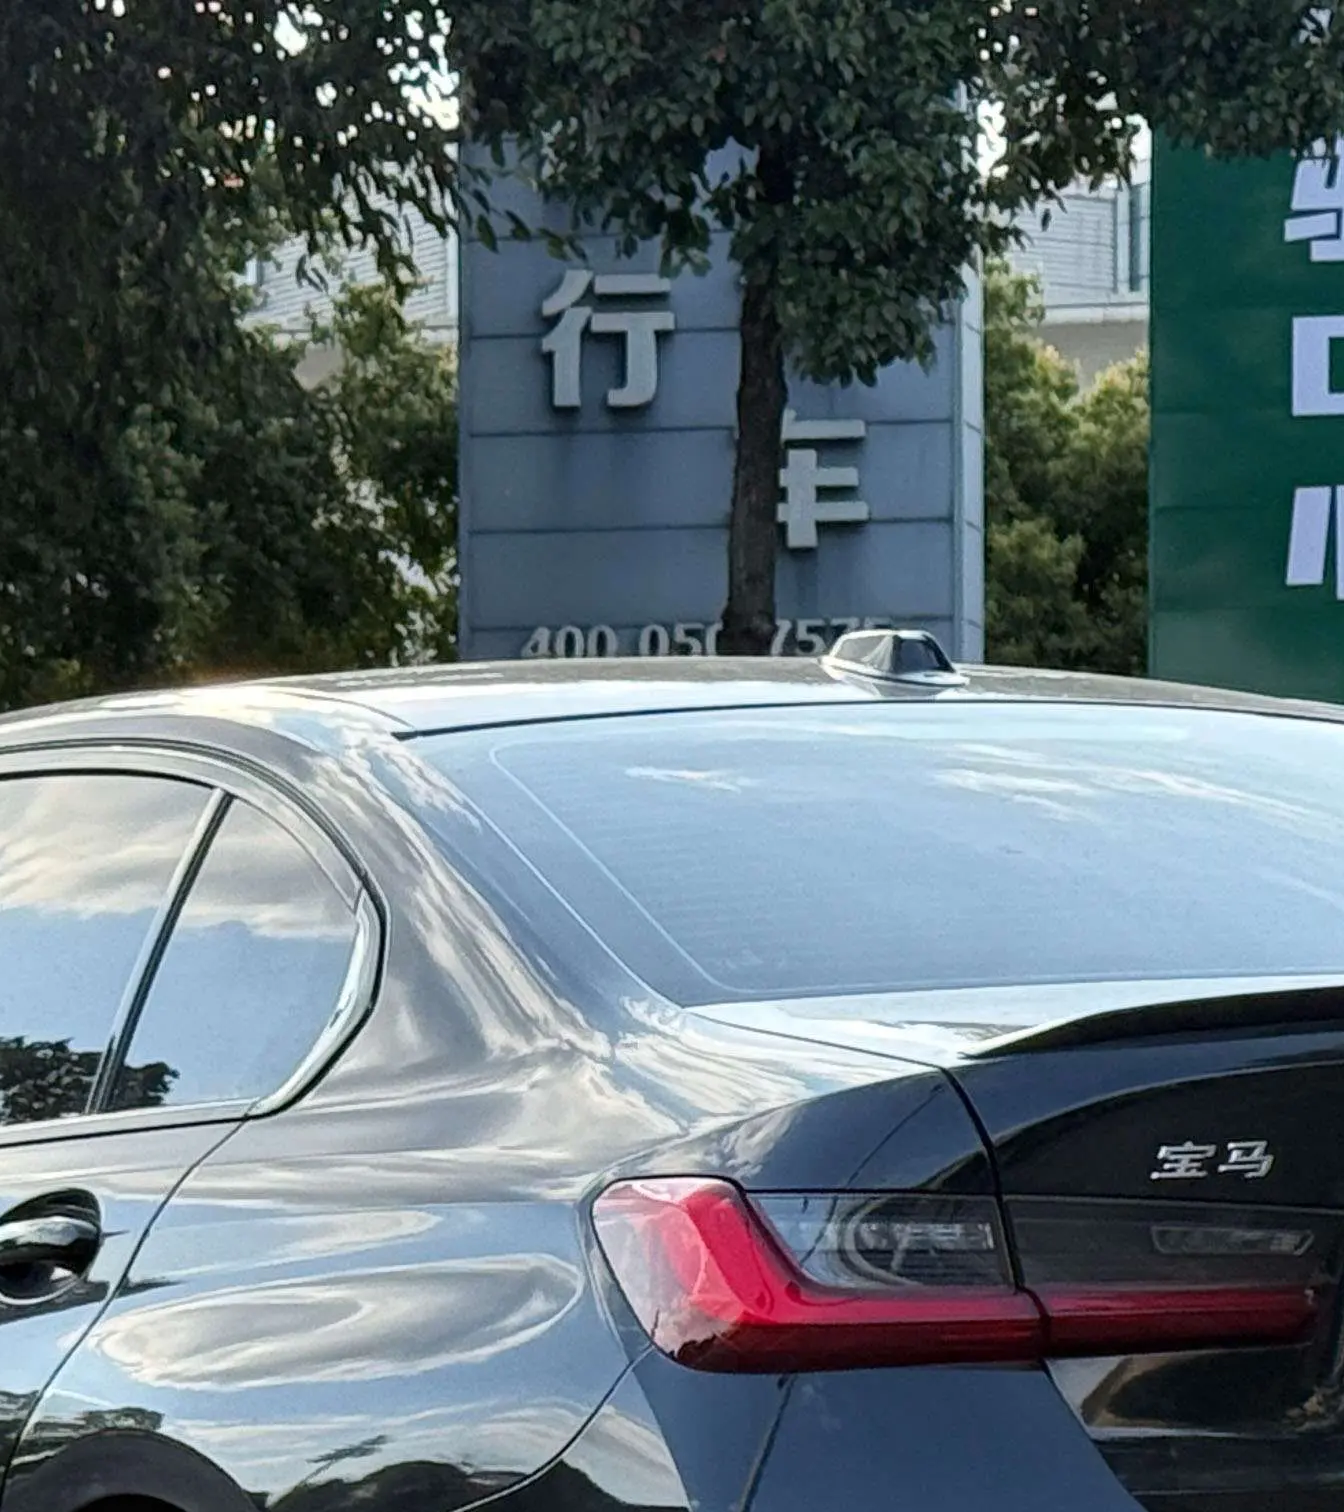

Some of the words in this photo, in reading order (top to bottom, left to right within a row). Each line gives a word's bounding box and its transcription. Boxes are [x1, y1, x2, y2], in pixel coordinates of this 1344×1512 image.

[542, 269, 675, 409] 行
[769, 617, 894, 657] 75
[1149, 1140, 1275, 1179] 宝马
